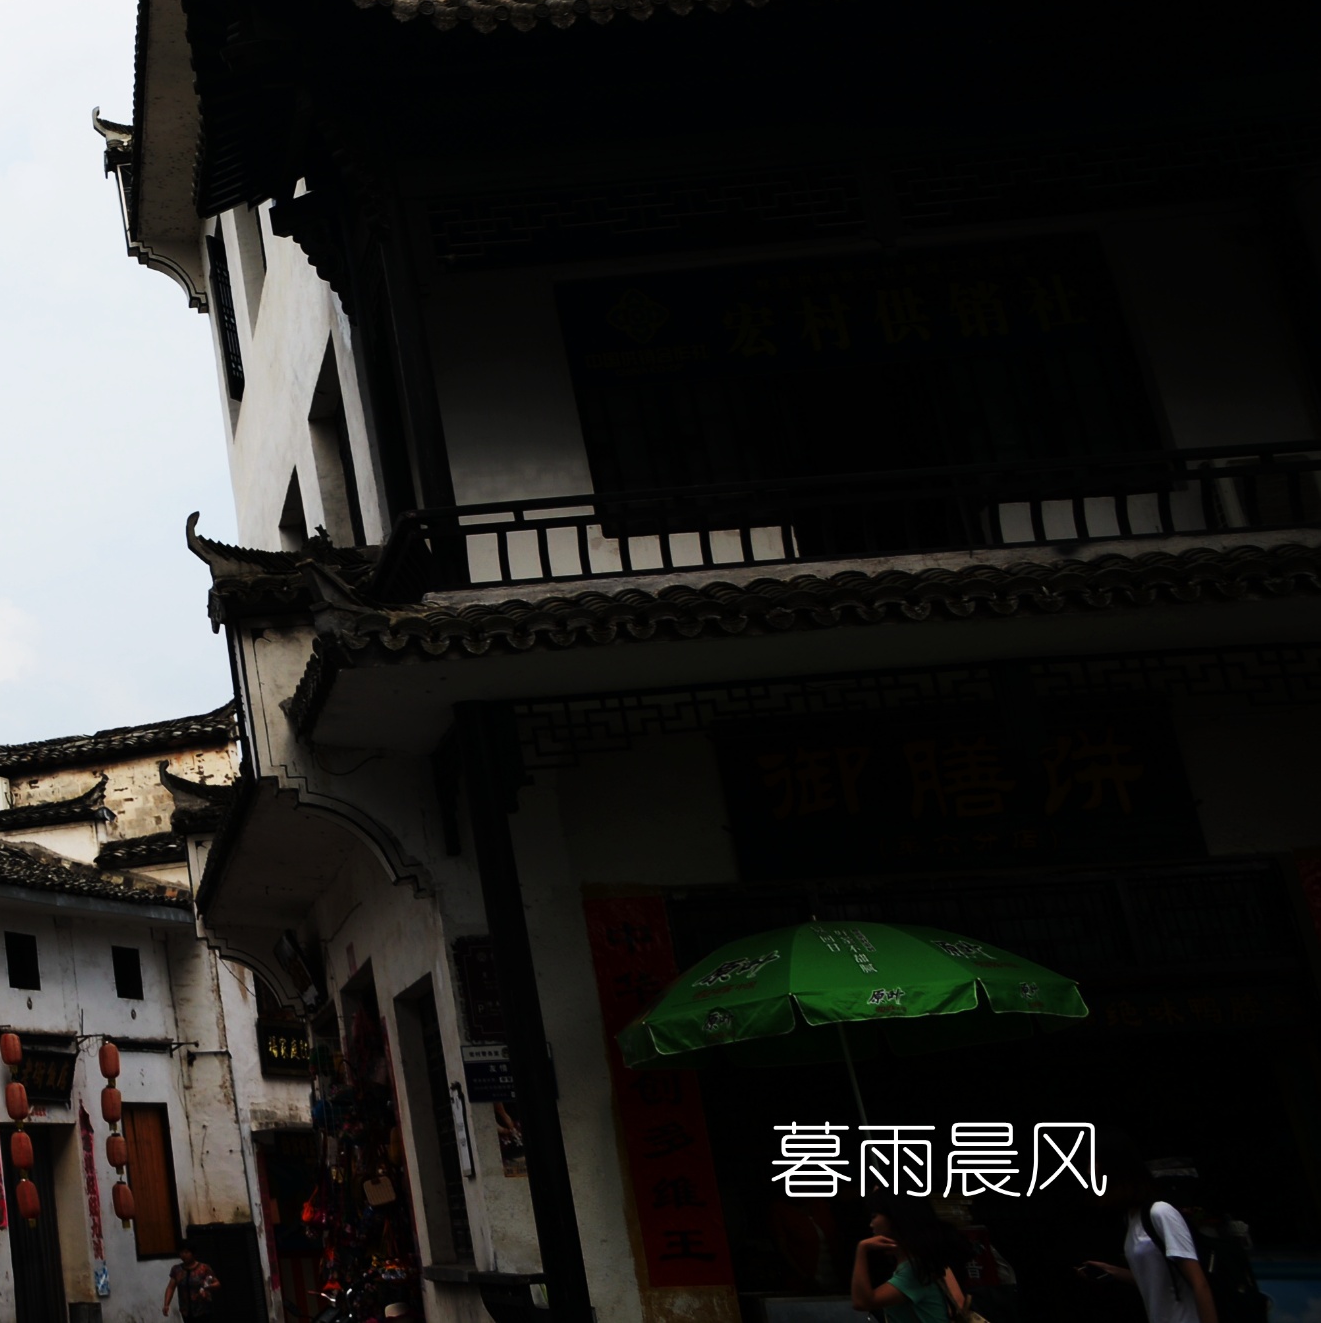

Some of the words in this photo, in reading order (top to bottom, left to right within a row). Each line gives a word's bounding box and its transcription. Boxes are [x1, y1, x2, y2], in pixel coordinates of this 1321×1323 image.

[722, 273, 1087, 358] 宏村供销社
[692, 950, 780, 986] 原叶
[866, 986, 906, 1005] 原叶
